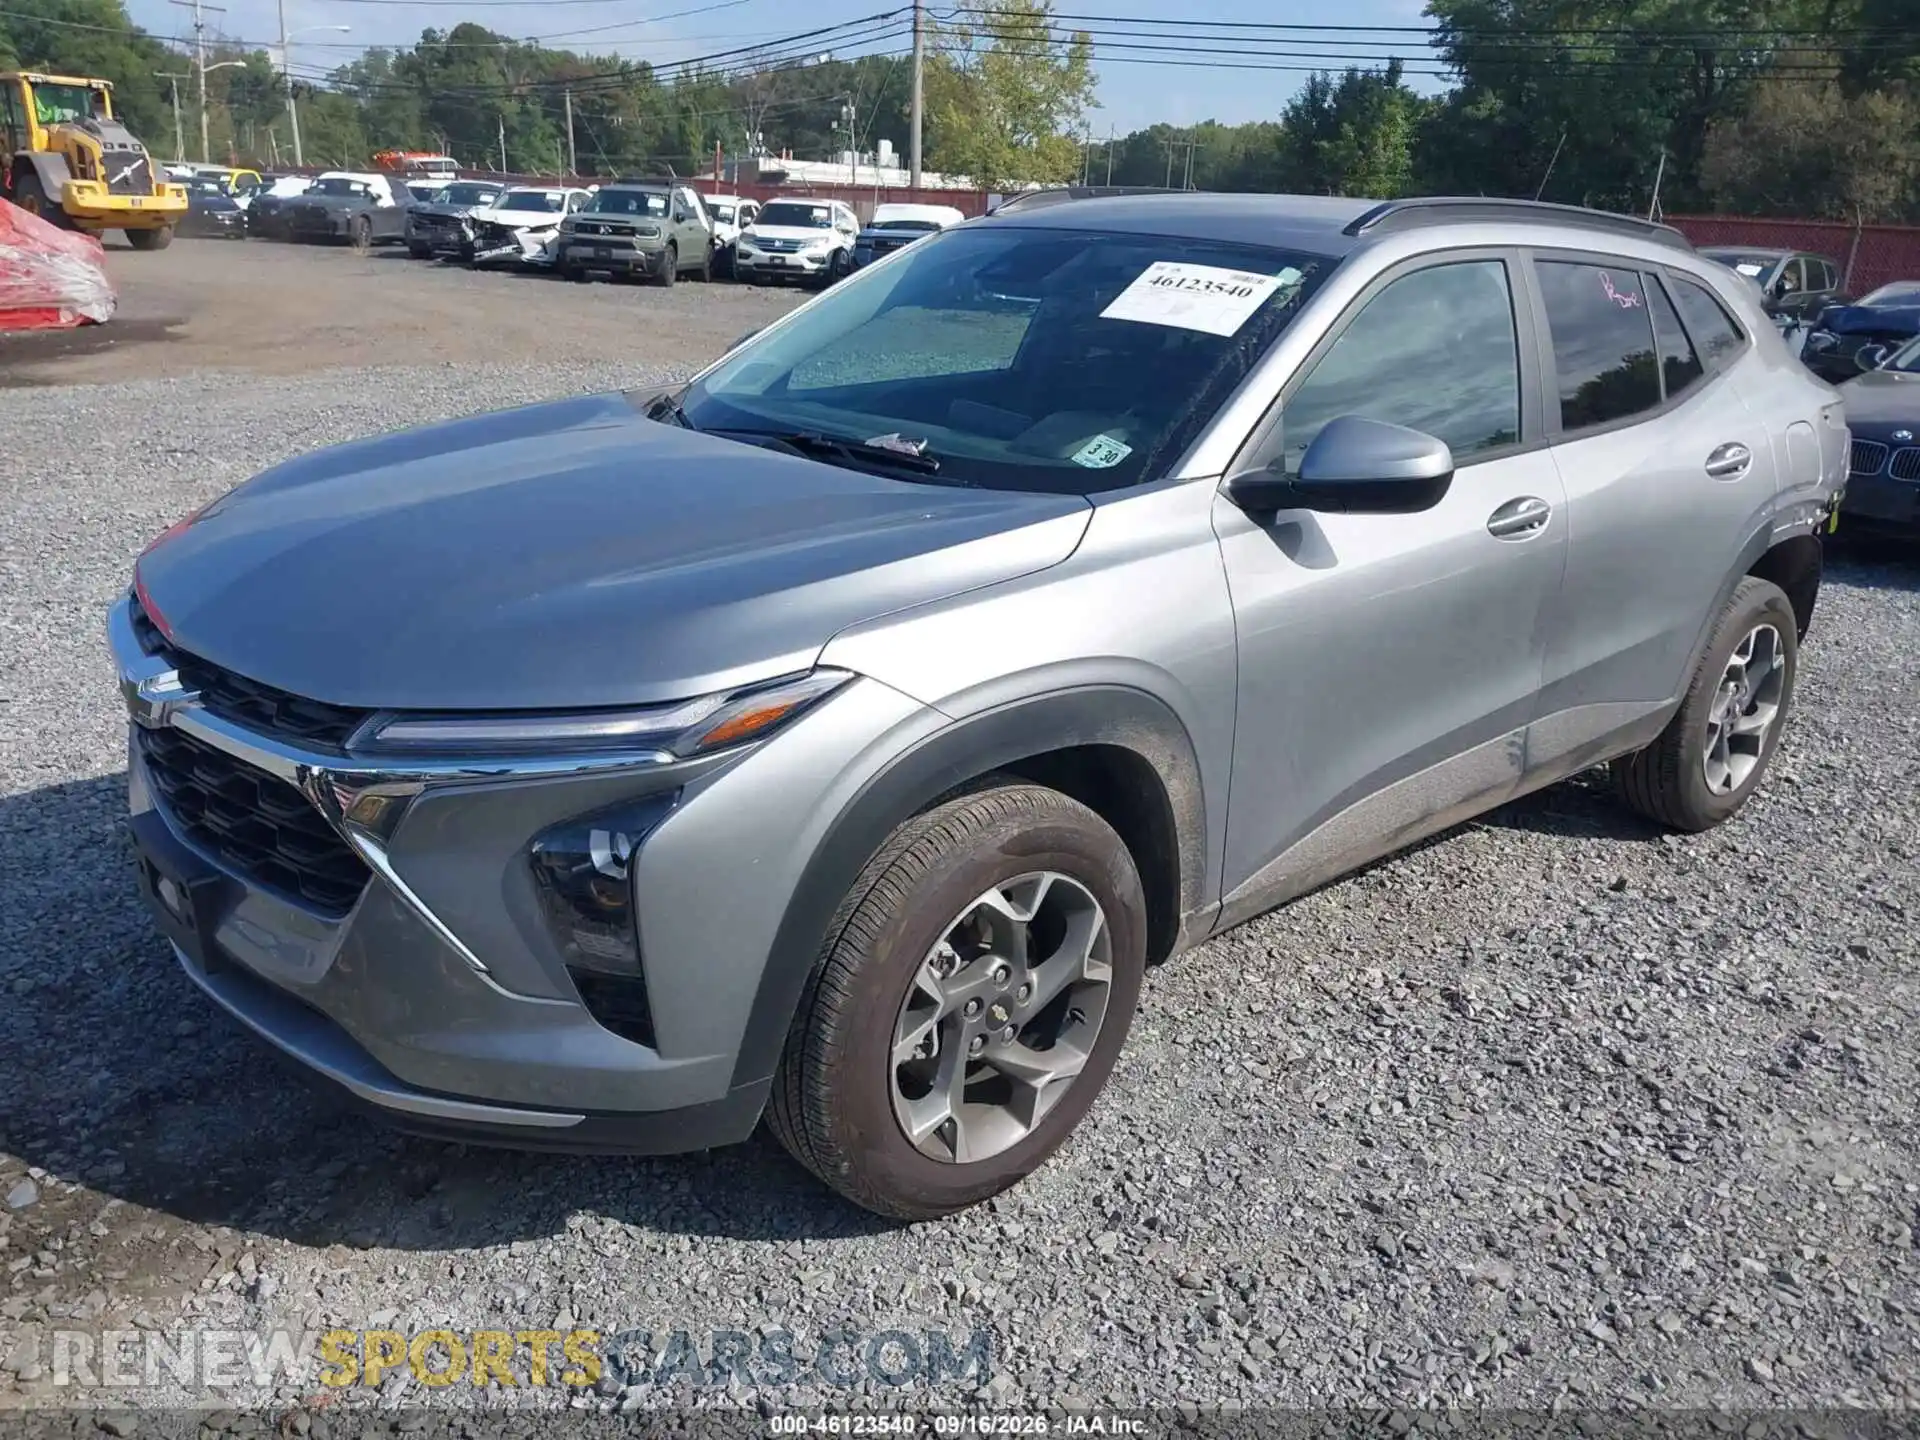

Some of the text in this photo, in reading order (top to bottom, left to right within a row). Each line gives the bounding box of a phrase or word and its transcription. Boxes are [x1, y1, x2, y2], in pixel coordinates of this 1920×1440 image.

[1148, 275, 1253, 298] 46123540
[1088, 443, 1102, 455] 3
[1100, 450, 1119, 464] 30
